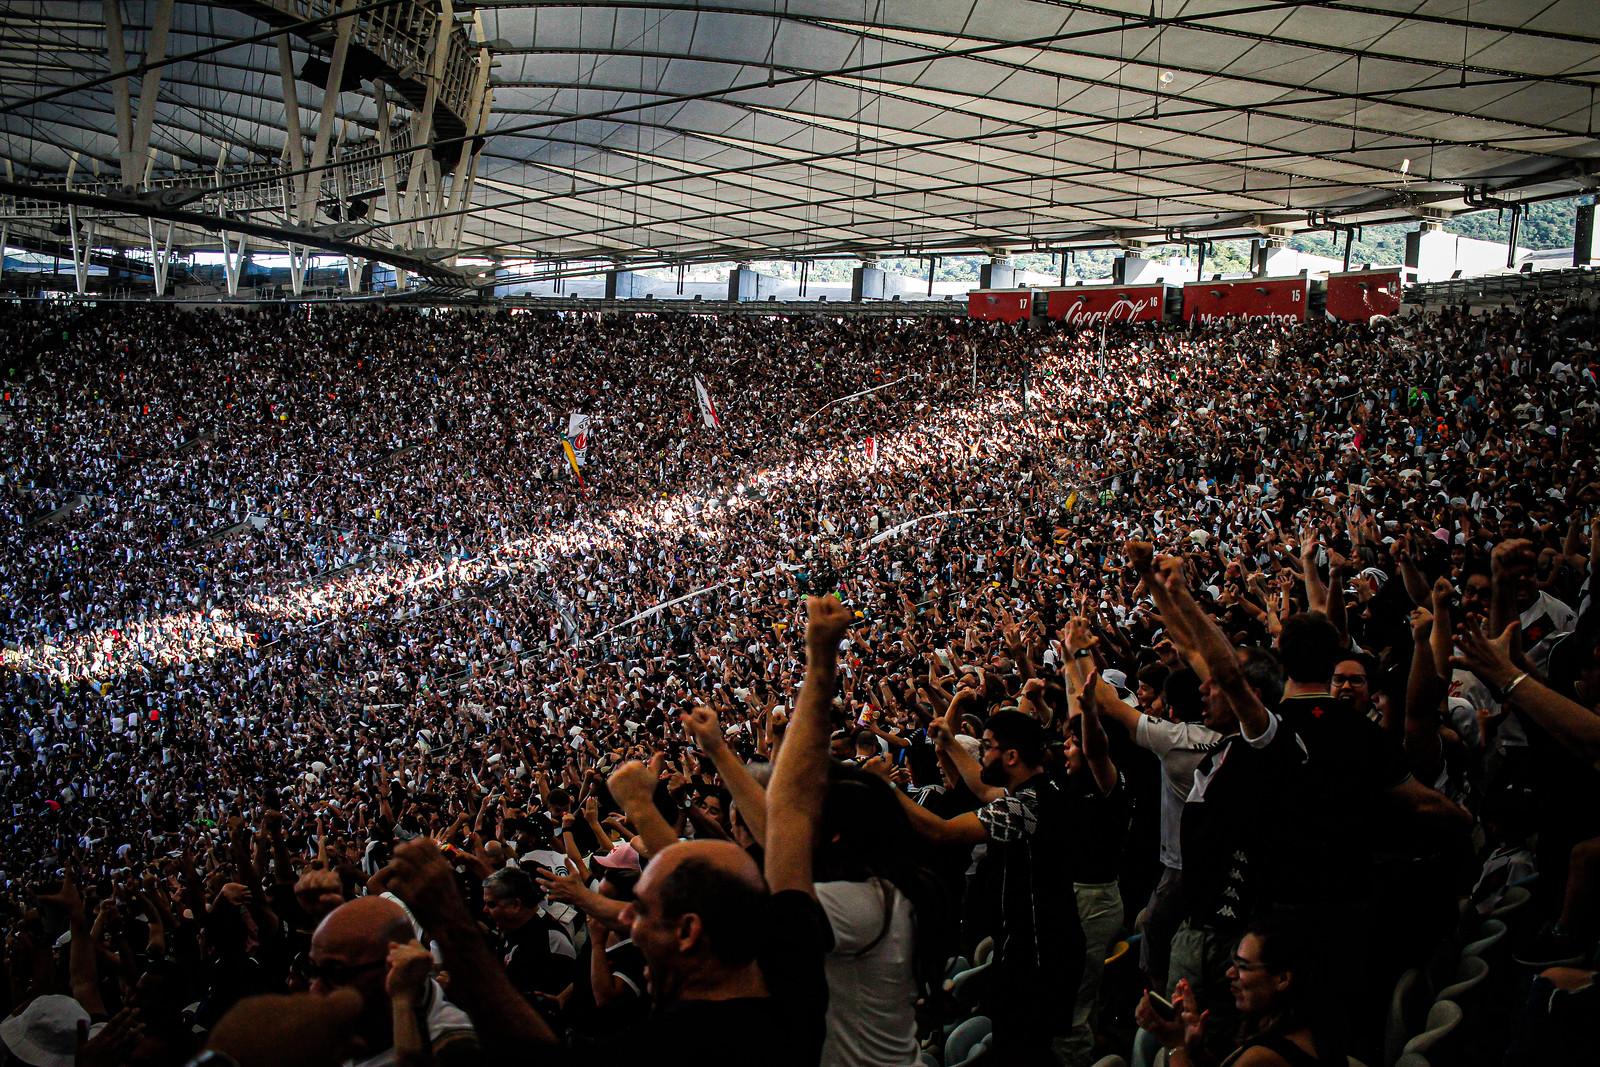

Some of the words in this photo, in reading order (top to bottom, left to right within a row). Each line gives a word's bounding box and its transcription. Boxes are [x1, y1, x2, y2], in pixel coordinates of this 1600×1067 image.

[1291, 290, 1300, 302] 15
[1019, 299, 1028, 309] 17
[1150, 297, 1158, 307] 16
